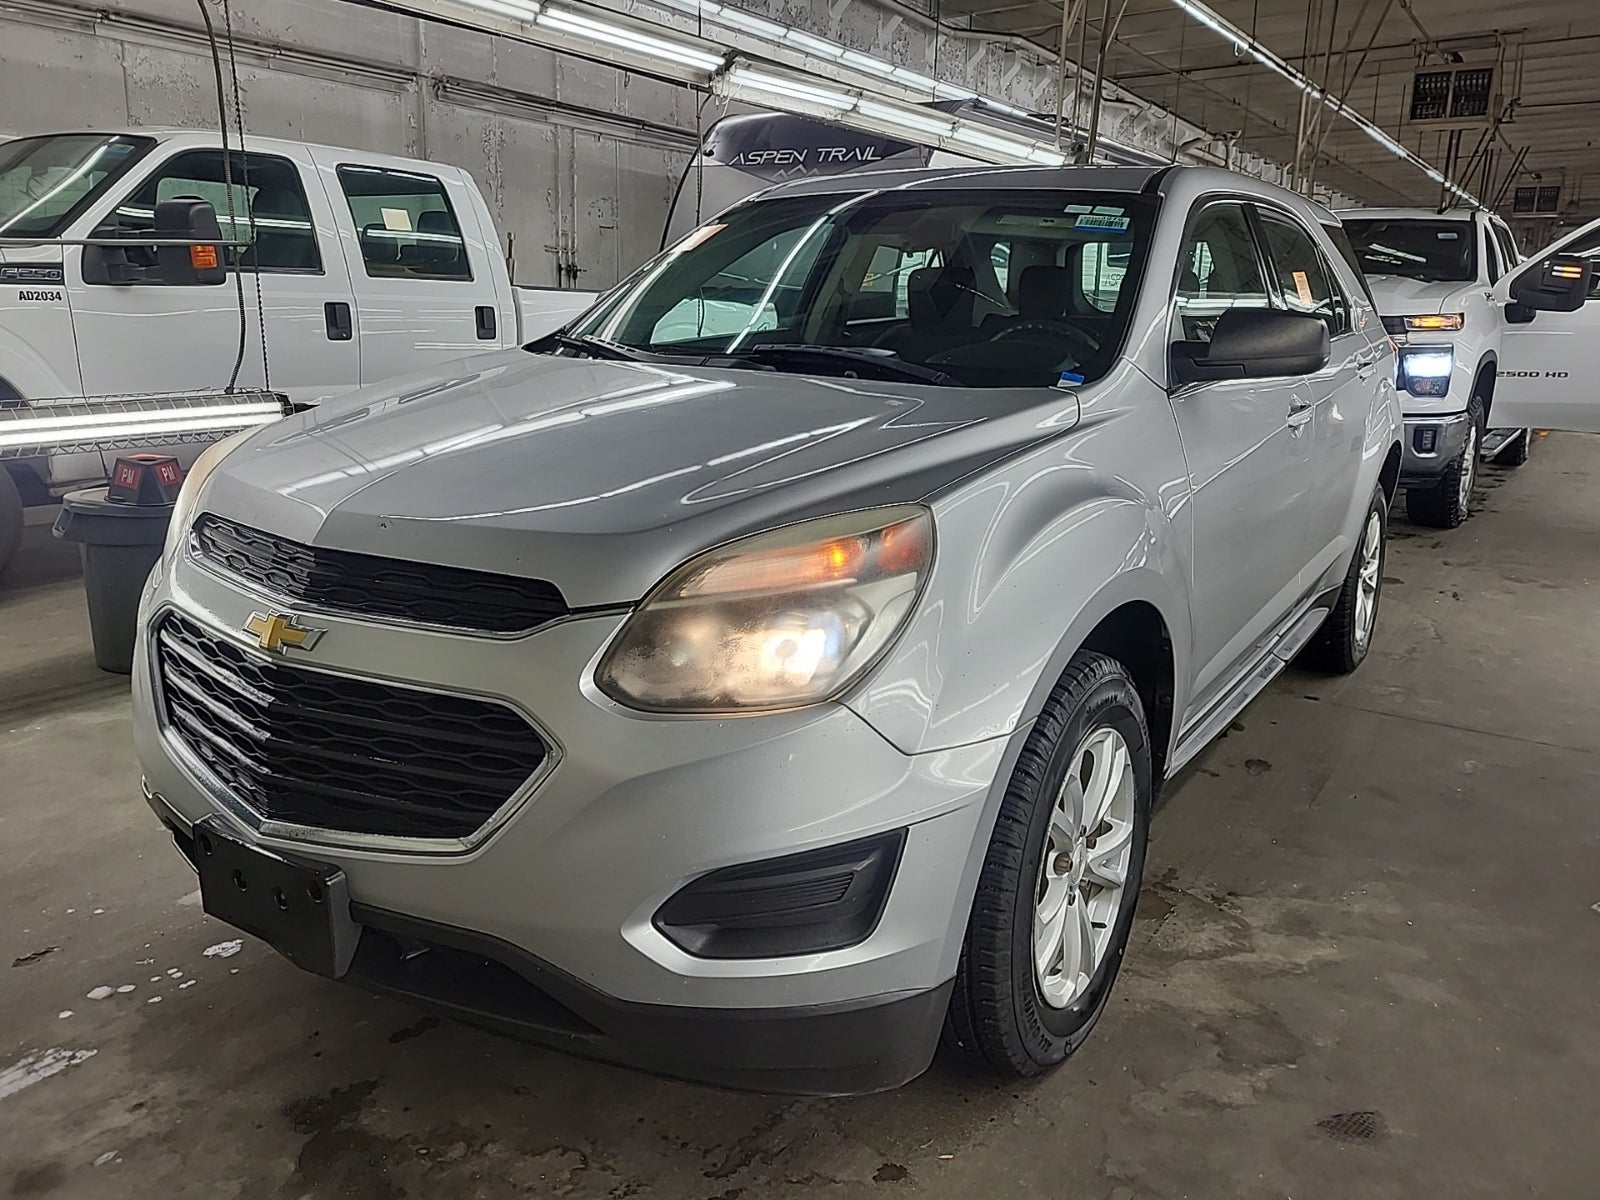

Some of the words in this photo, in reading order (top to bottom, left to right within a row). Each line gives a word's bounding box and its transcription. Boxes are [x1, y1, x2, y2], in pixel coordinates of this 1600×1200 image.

[729, 149, 808, 165] ASPEN
[817, 146, 882, 161] TRAIL
[19, 290, 62, 301] AD2034
[120, 468, 135, 485] PM
[161, 465, 176, 482] PM
